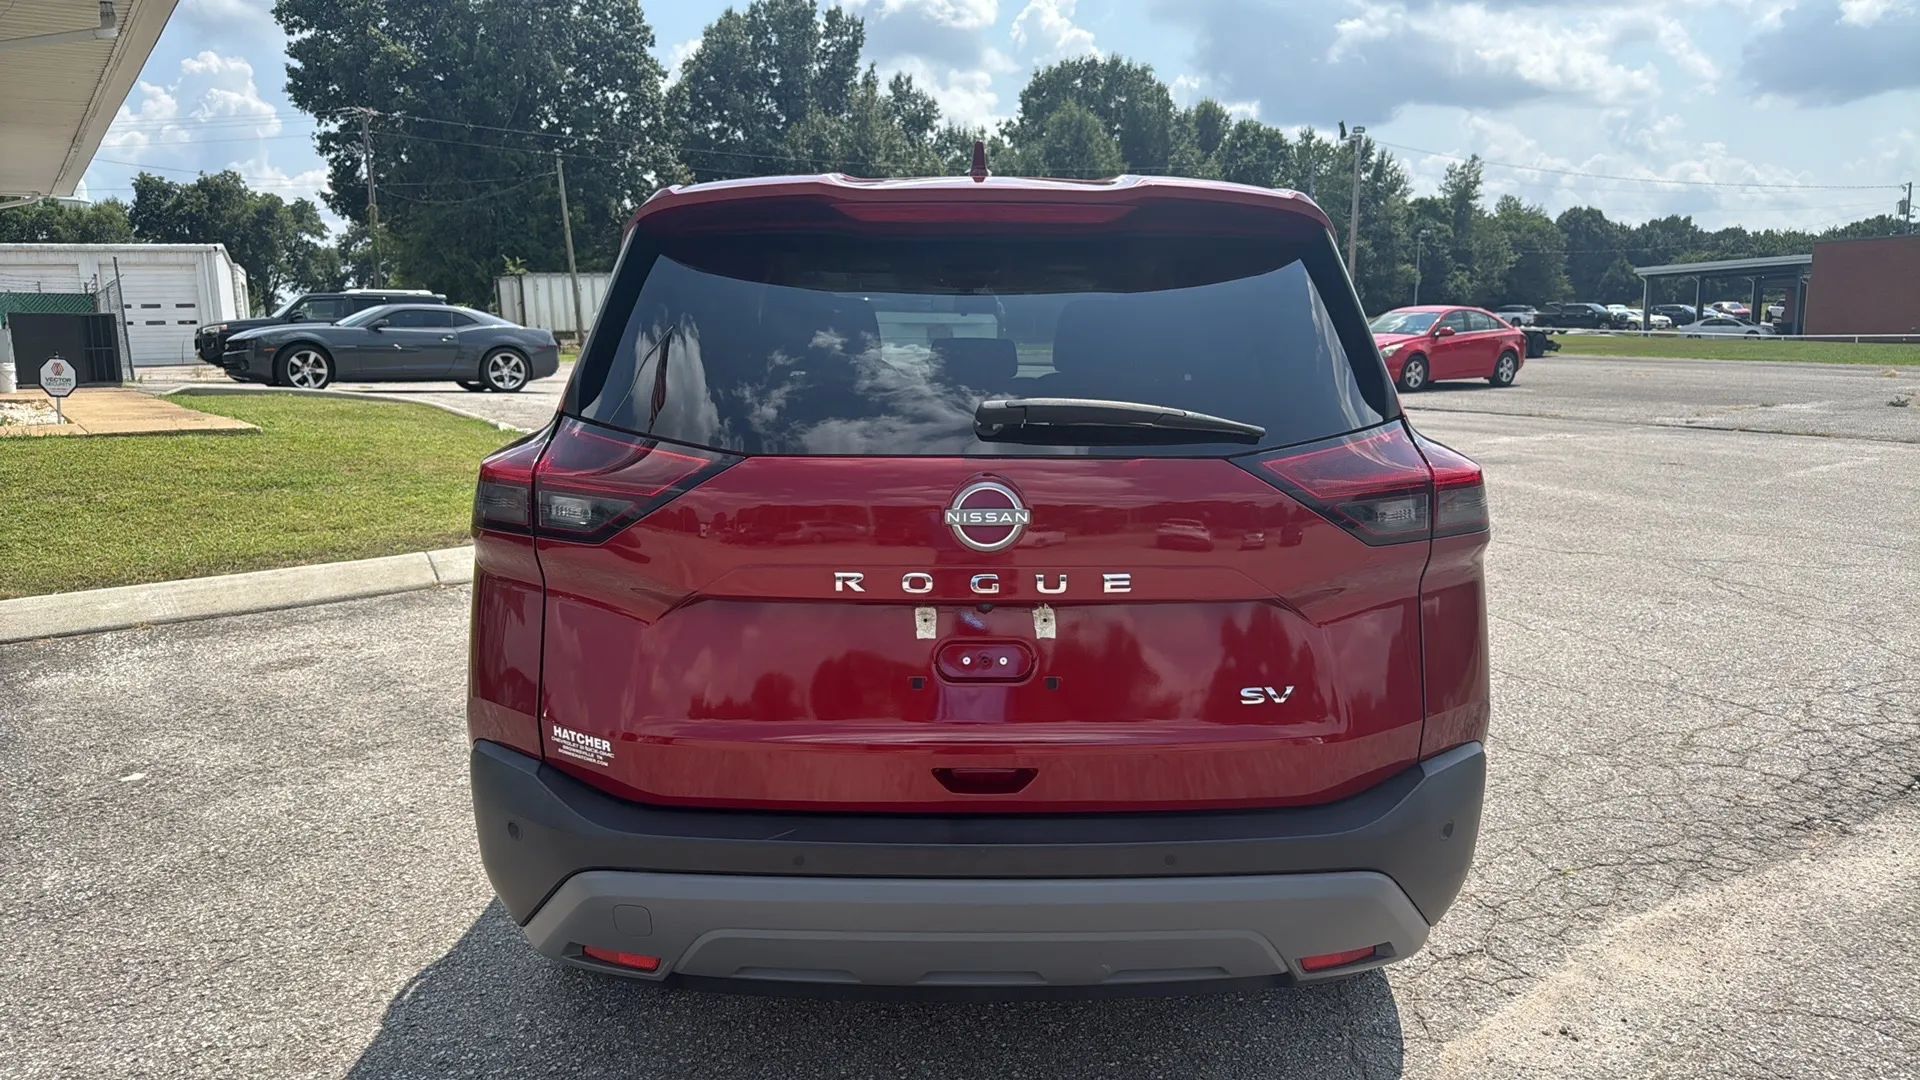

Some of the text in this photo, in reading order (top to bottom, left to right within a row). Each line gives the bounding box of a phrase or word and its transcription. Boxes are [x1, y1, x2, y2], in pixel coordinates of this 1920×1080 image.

[947, 512, 1028, 522] NISSAN
[833, 572, 1132, 594] ROGUE
[1240, 685, 1294, 705] SV
[553, 725, 611, 752] HATCHER
